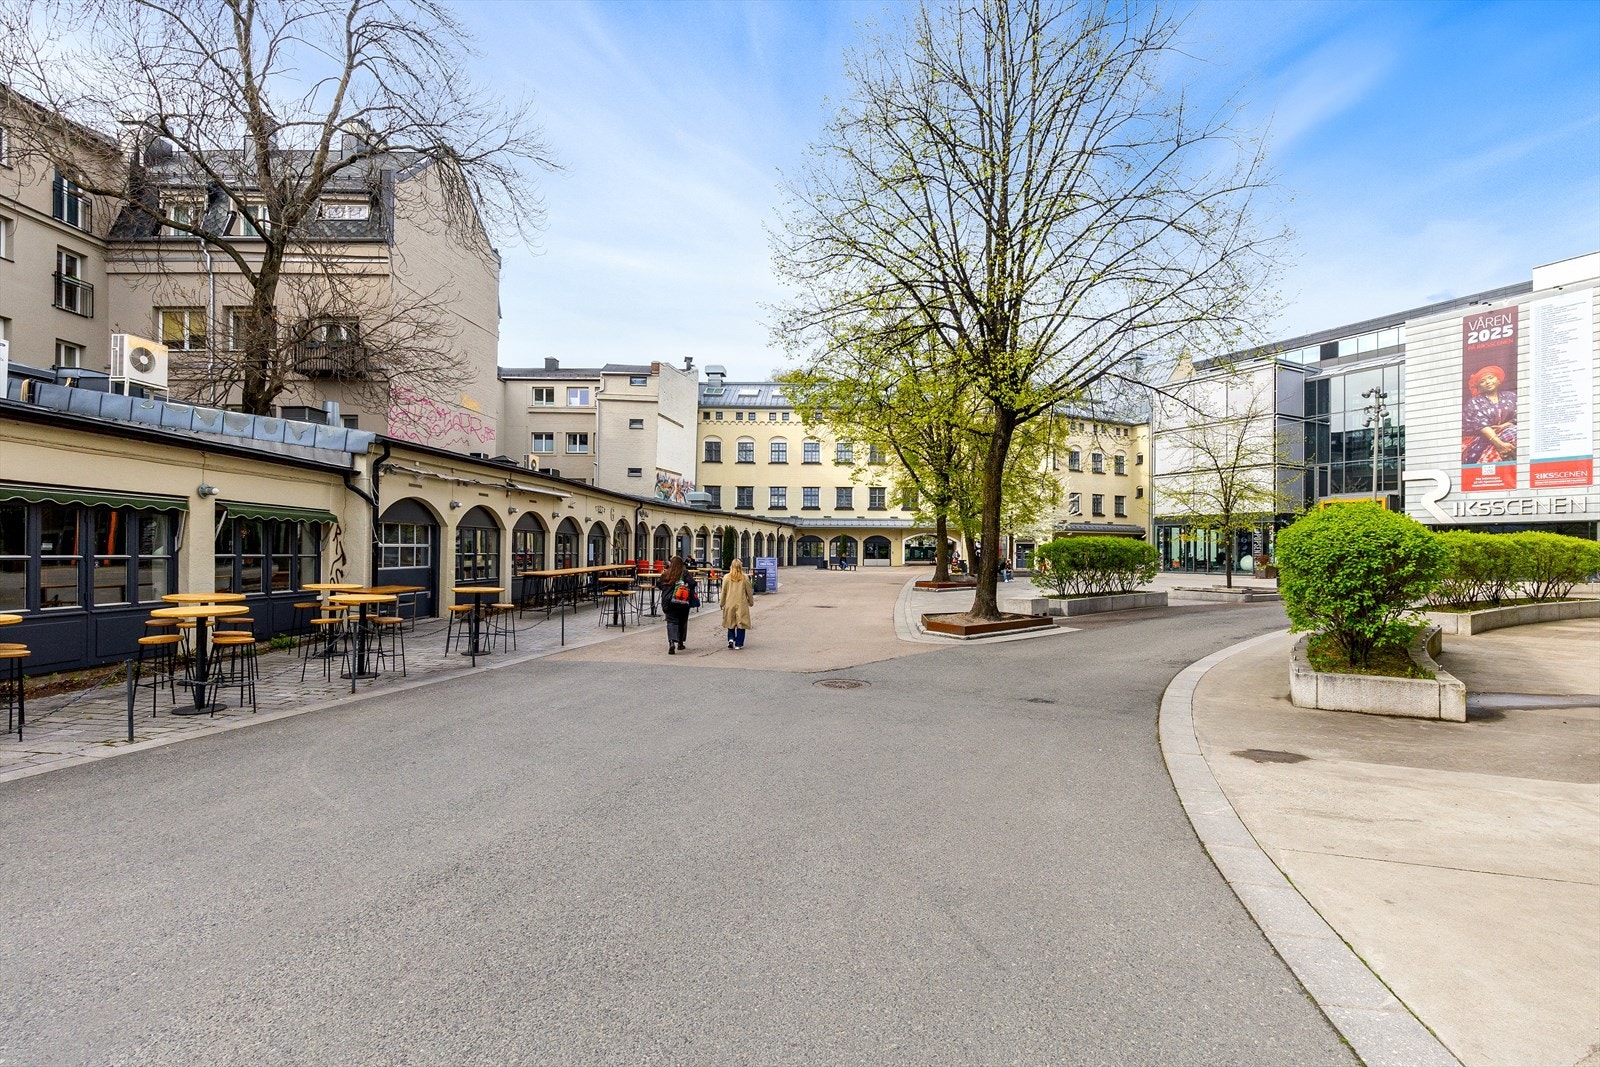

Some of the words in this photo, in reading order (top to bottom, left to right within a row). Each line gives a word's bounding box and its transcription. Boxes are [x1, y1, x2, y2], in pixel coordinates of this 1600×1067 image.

[1468, 313, 1512, 331] VÅREN
[1467, 324, 1514, 345] 2025
[1534, 470, 1588, 479] RIKSSCENEN
[1402, 469, 1588, 524] RIKSSCENEN
